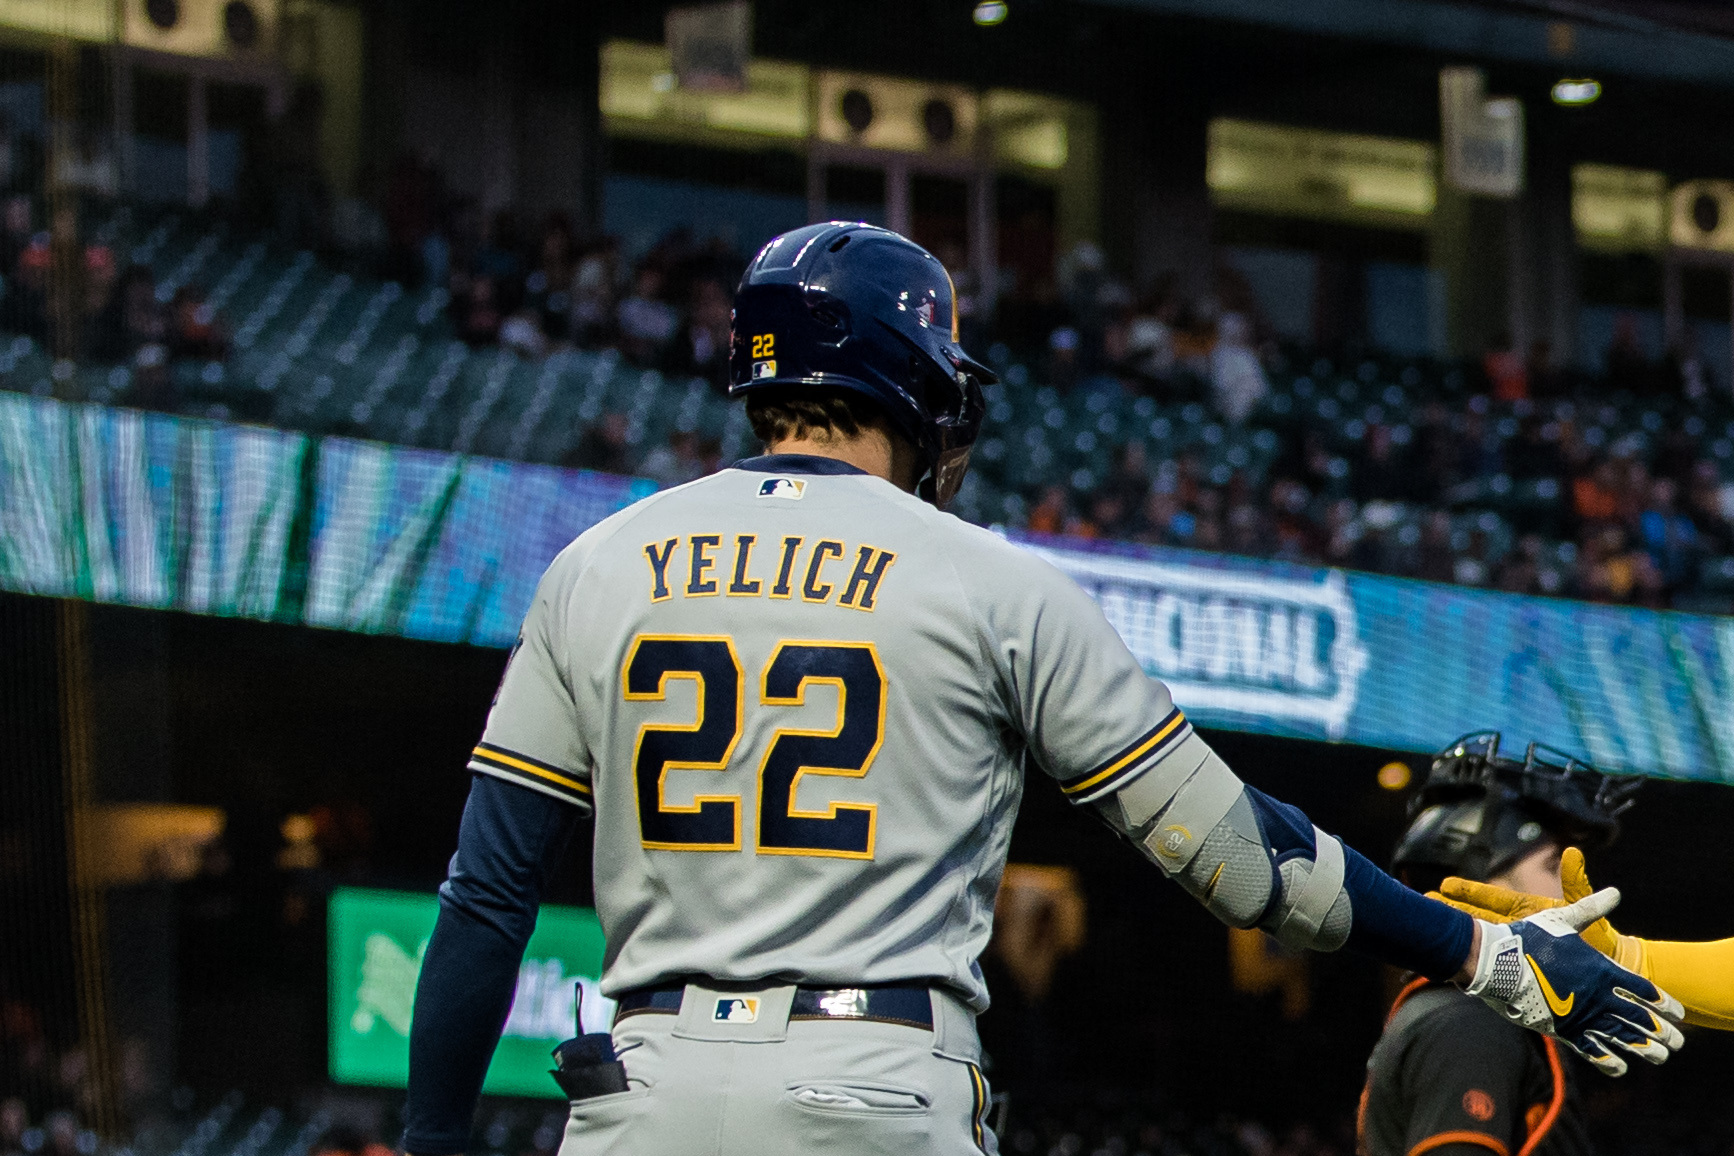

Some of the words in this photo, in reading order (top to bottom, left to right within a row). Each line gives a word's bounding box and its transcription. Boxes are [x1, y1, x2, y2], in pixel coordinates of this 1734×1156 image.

[752, 333, 775, 358] 22
[642, 532, 898, 613] YELICH
[622, 632, 889, 860] 22
[1165, 832, 1185, 851] 22
